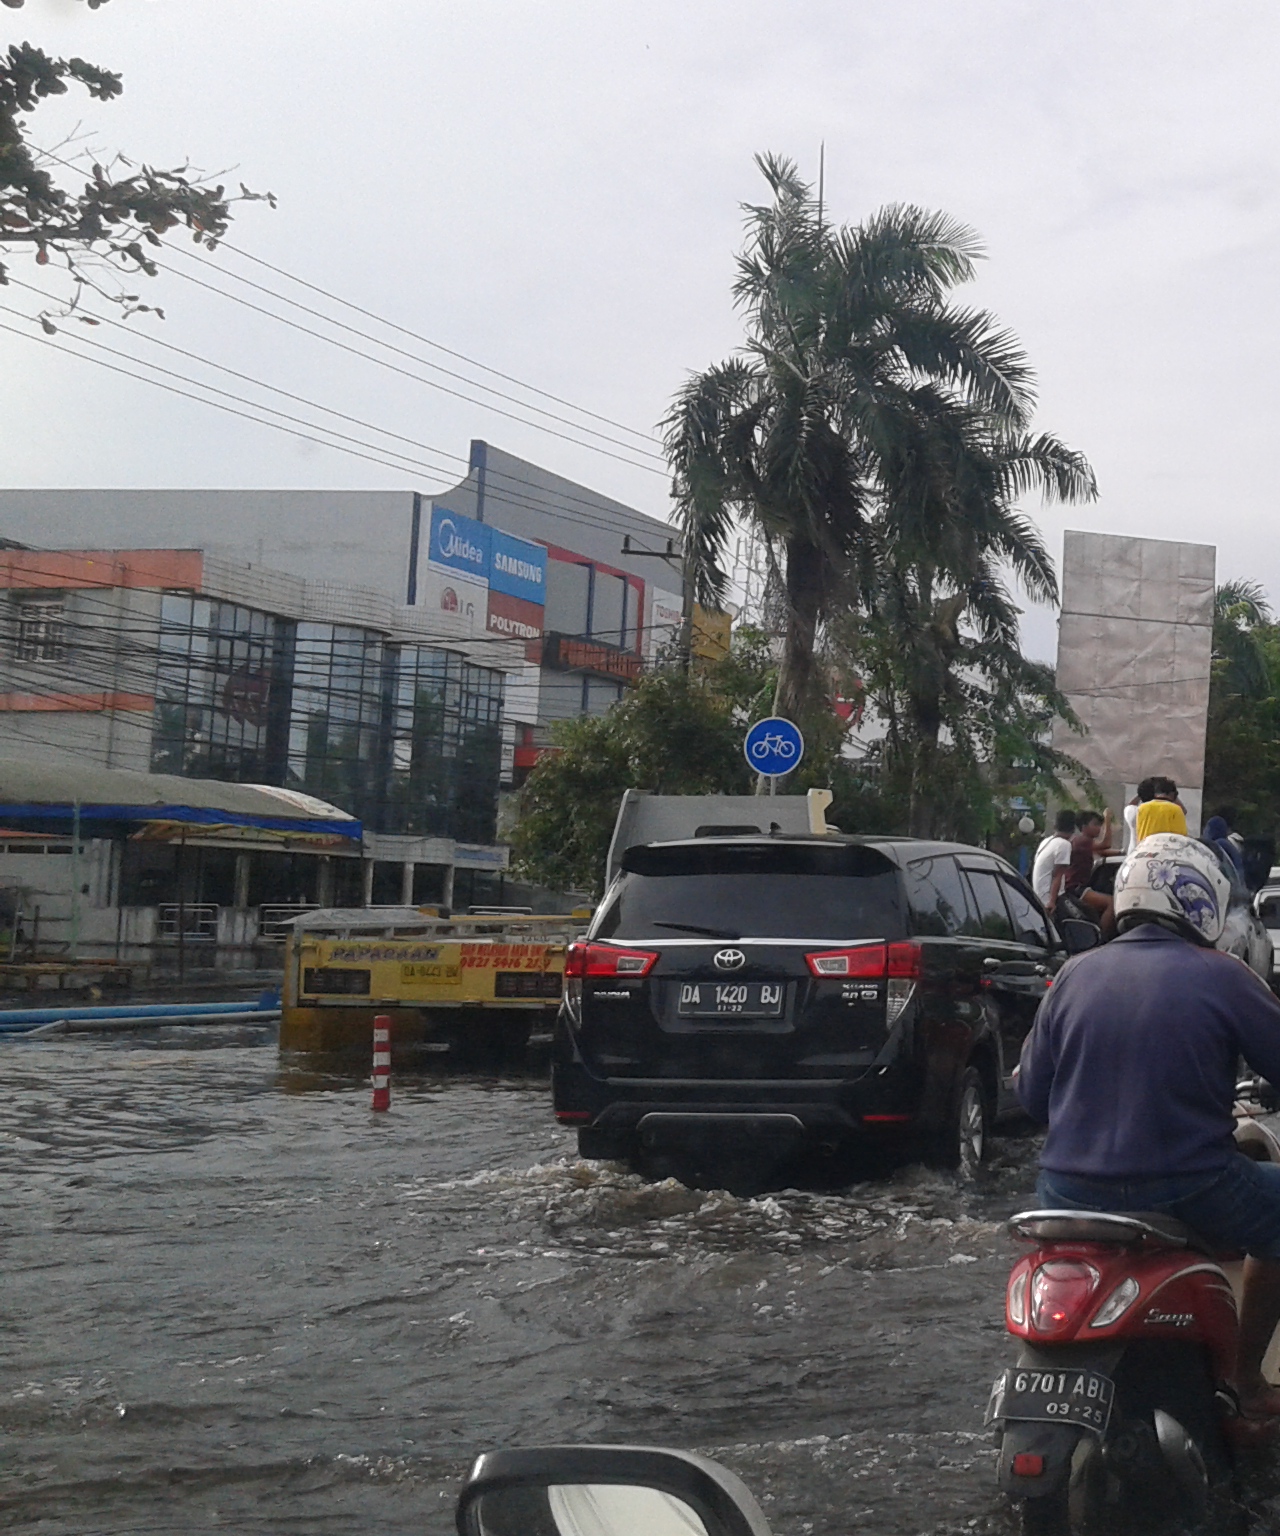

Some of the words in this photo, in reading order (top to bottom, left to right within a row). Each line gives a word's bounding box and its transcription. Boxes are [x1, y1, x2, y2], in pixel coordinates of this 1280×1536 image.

[494, 552, 542, 584] SAMSUNG
[490, 613, 541, 639] POLYTRON
[682, 985, 701, 1004] DA
[715, 985, 748, 1004] 1420
[760, 985, 780, 1004] BJ
[1015, 1372, 1067, 1394] 6701
[1072, 1374, 1107, 1404] ABL
